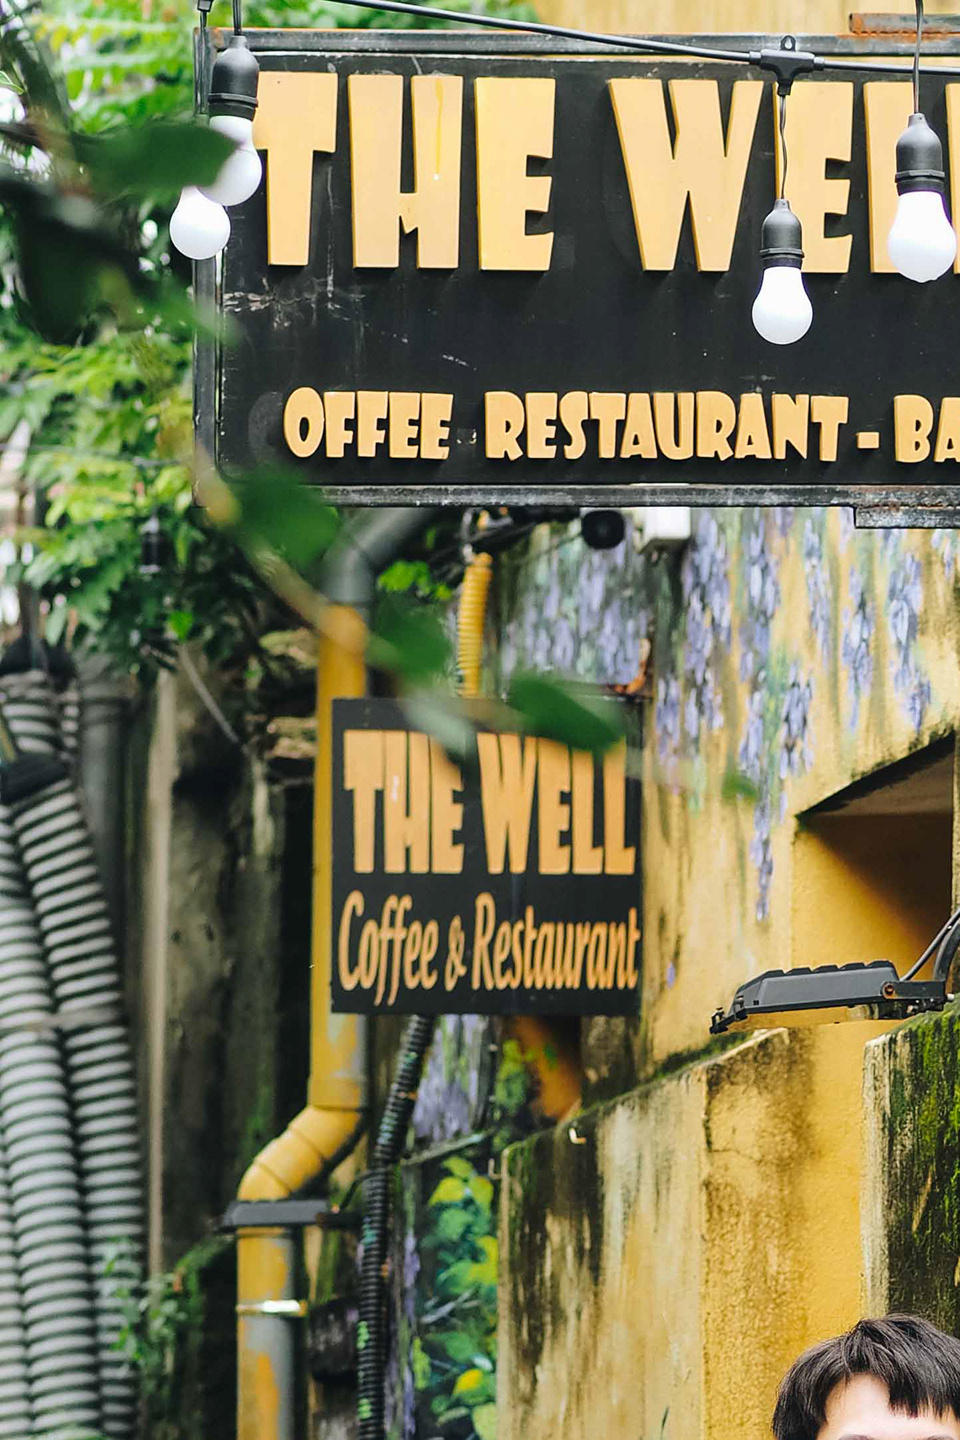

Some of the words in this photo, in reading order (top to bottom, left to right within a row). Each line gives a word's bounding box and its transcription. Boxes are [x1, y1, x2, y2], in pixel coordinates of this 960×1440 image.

[252, 71, 556, 272] THE
[283, 386, 454, 460] OFFEE
[486, 391, 850, 463] RESTAURANT
[343, 729, 464, 875] THE
[477, 731, 636, 875] WELL
[338, 890, 439, 1006] Coffee
[444, 915, 467, 991] &
[471, 892, 641, 990] Restaurant
